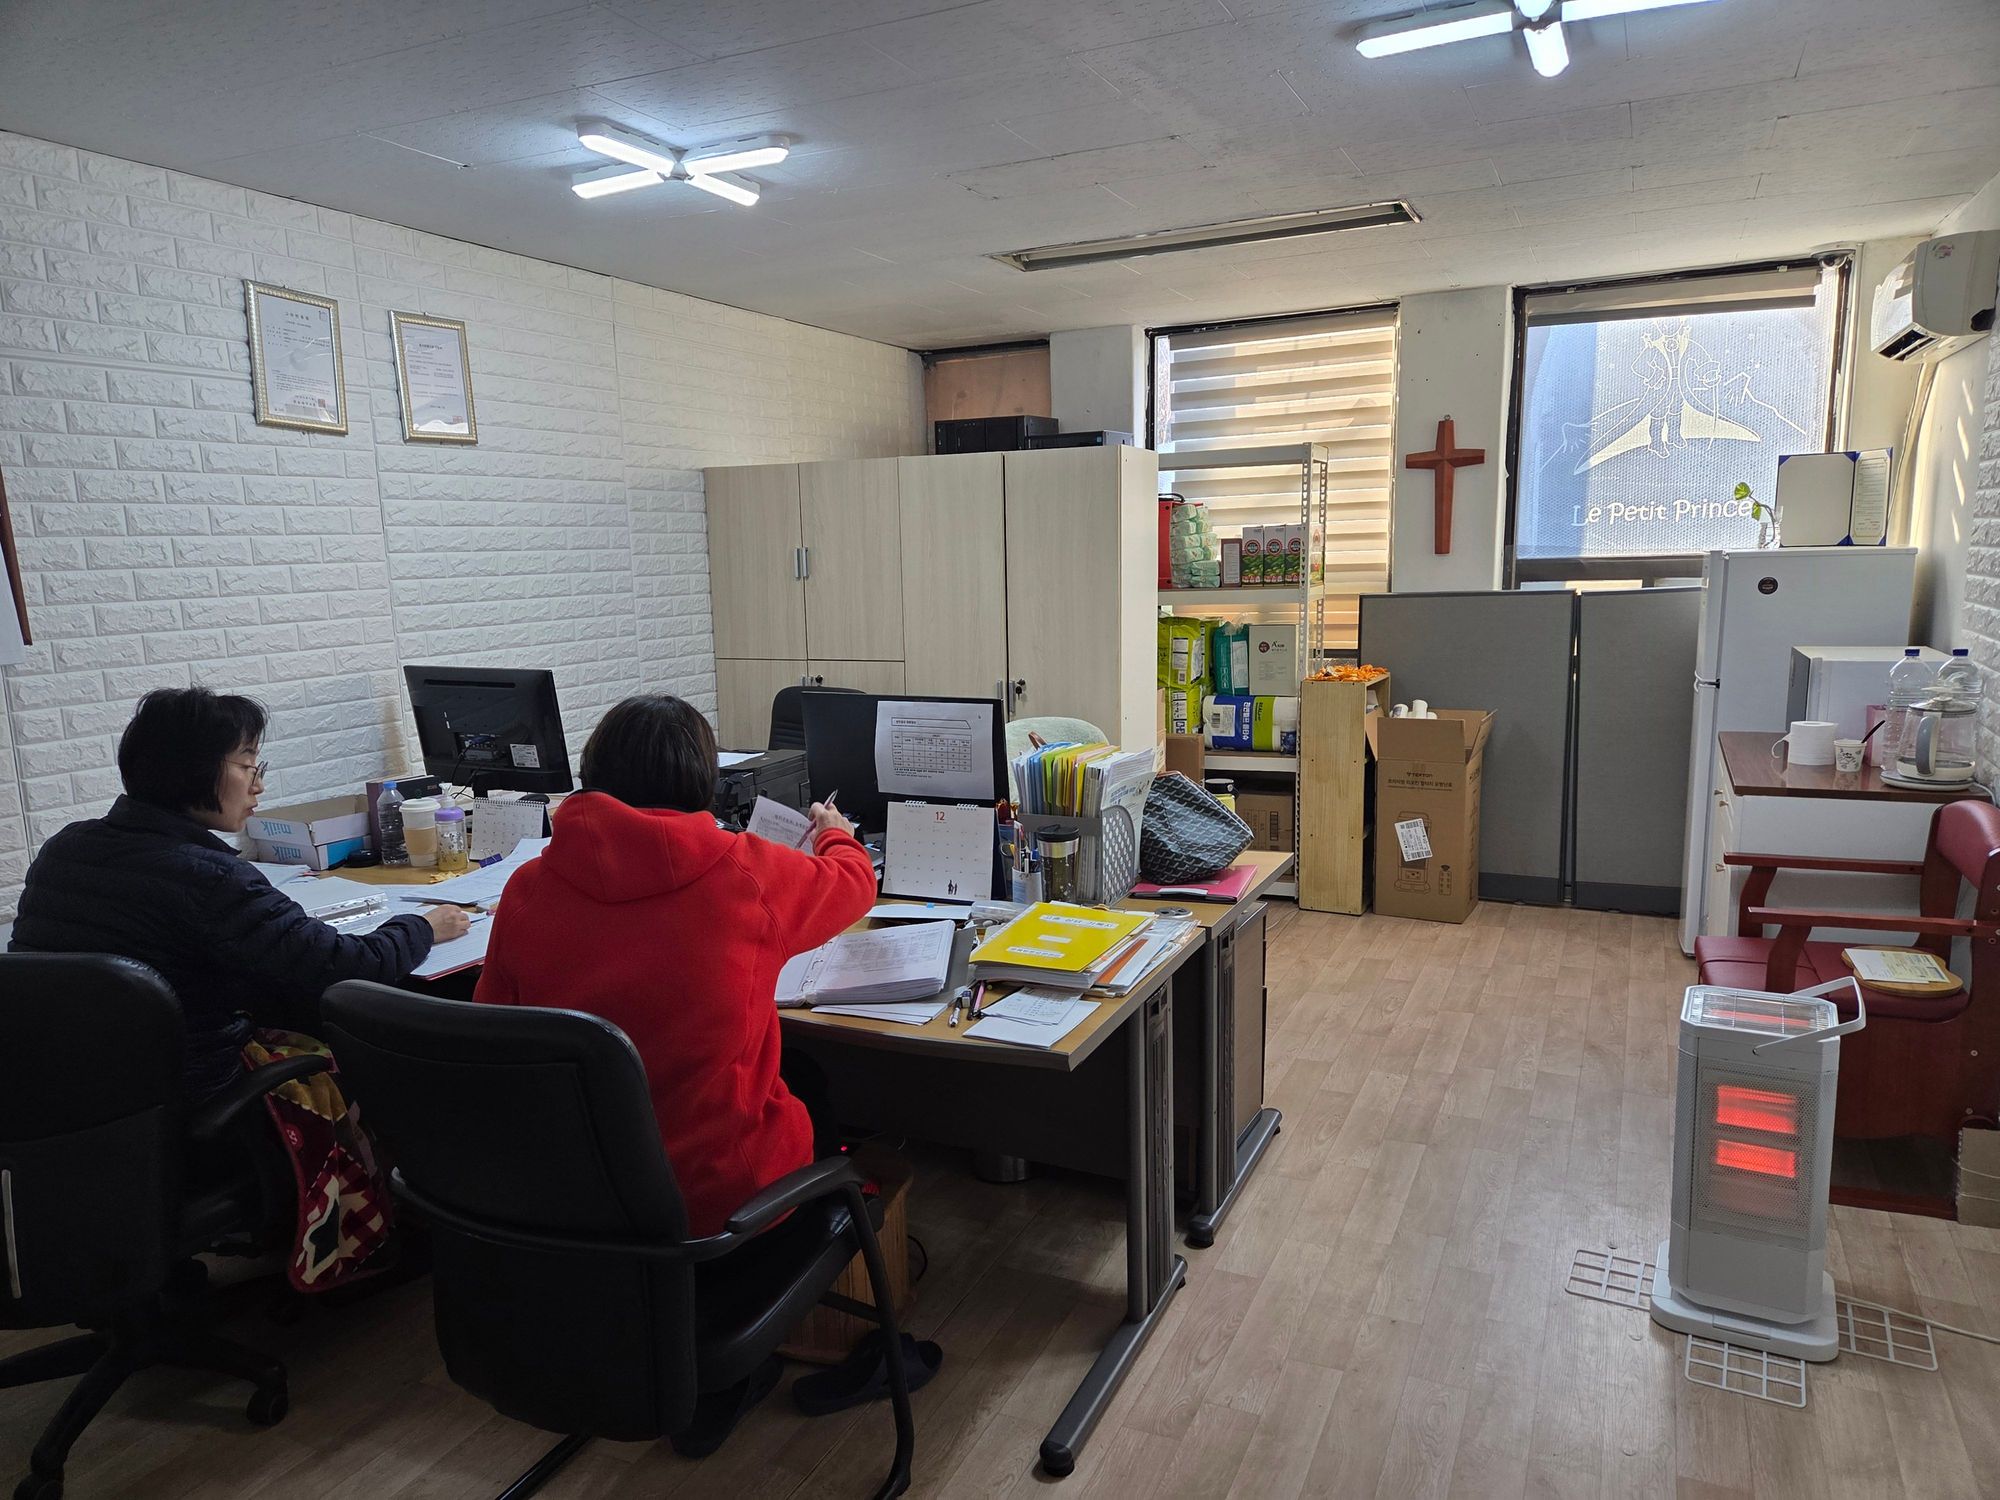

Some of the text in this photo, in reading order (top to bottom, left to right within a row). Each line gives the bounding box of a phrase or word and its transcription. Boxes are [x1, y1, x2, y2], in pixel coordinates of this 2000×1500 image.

[1571, 498, 1751, 527] Le Petit Prince
[935, 811, 945, 821] 12
